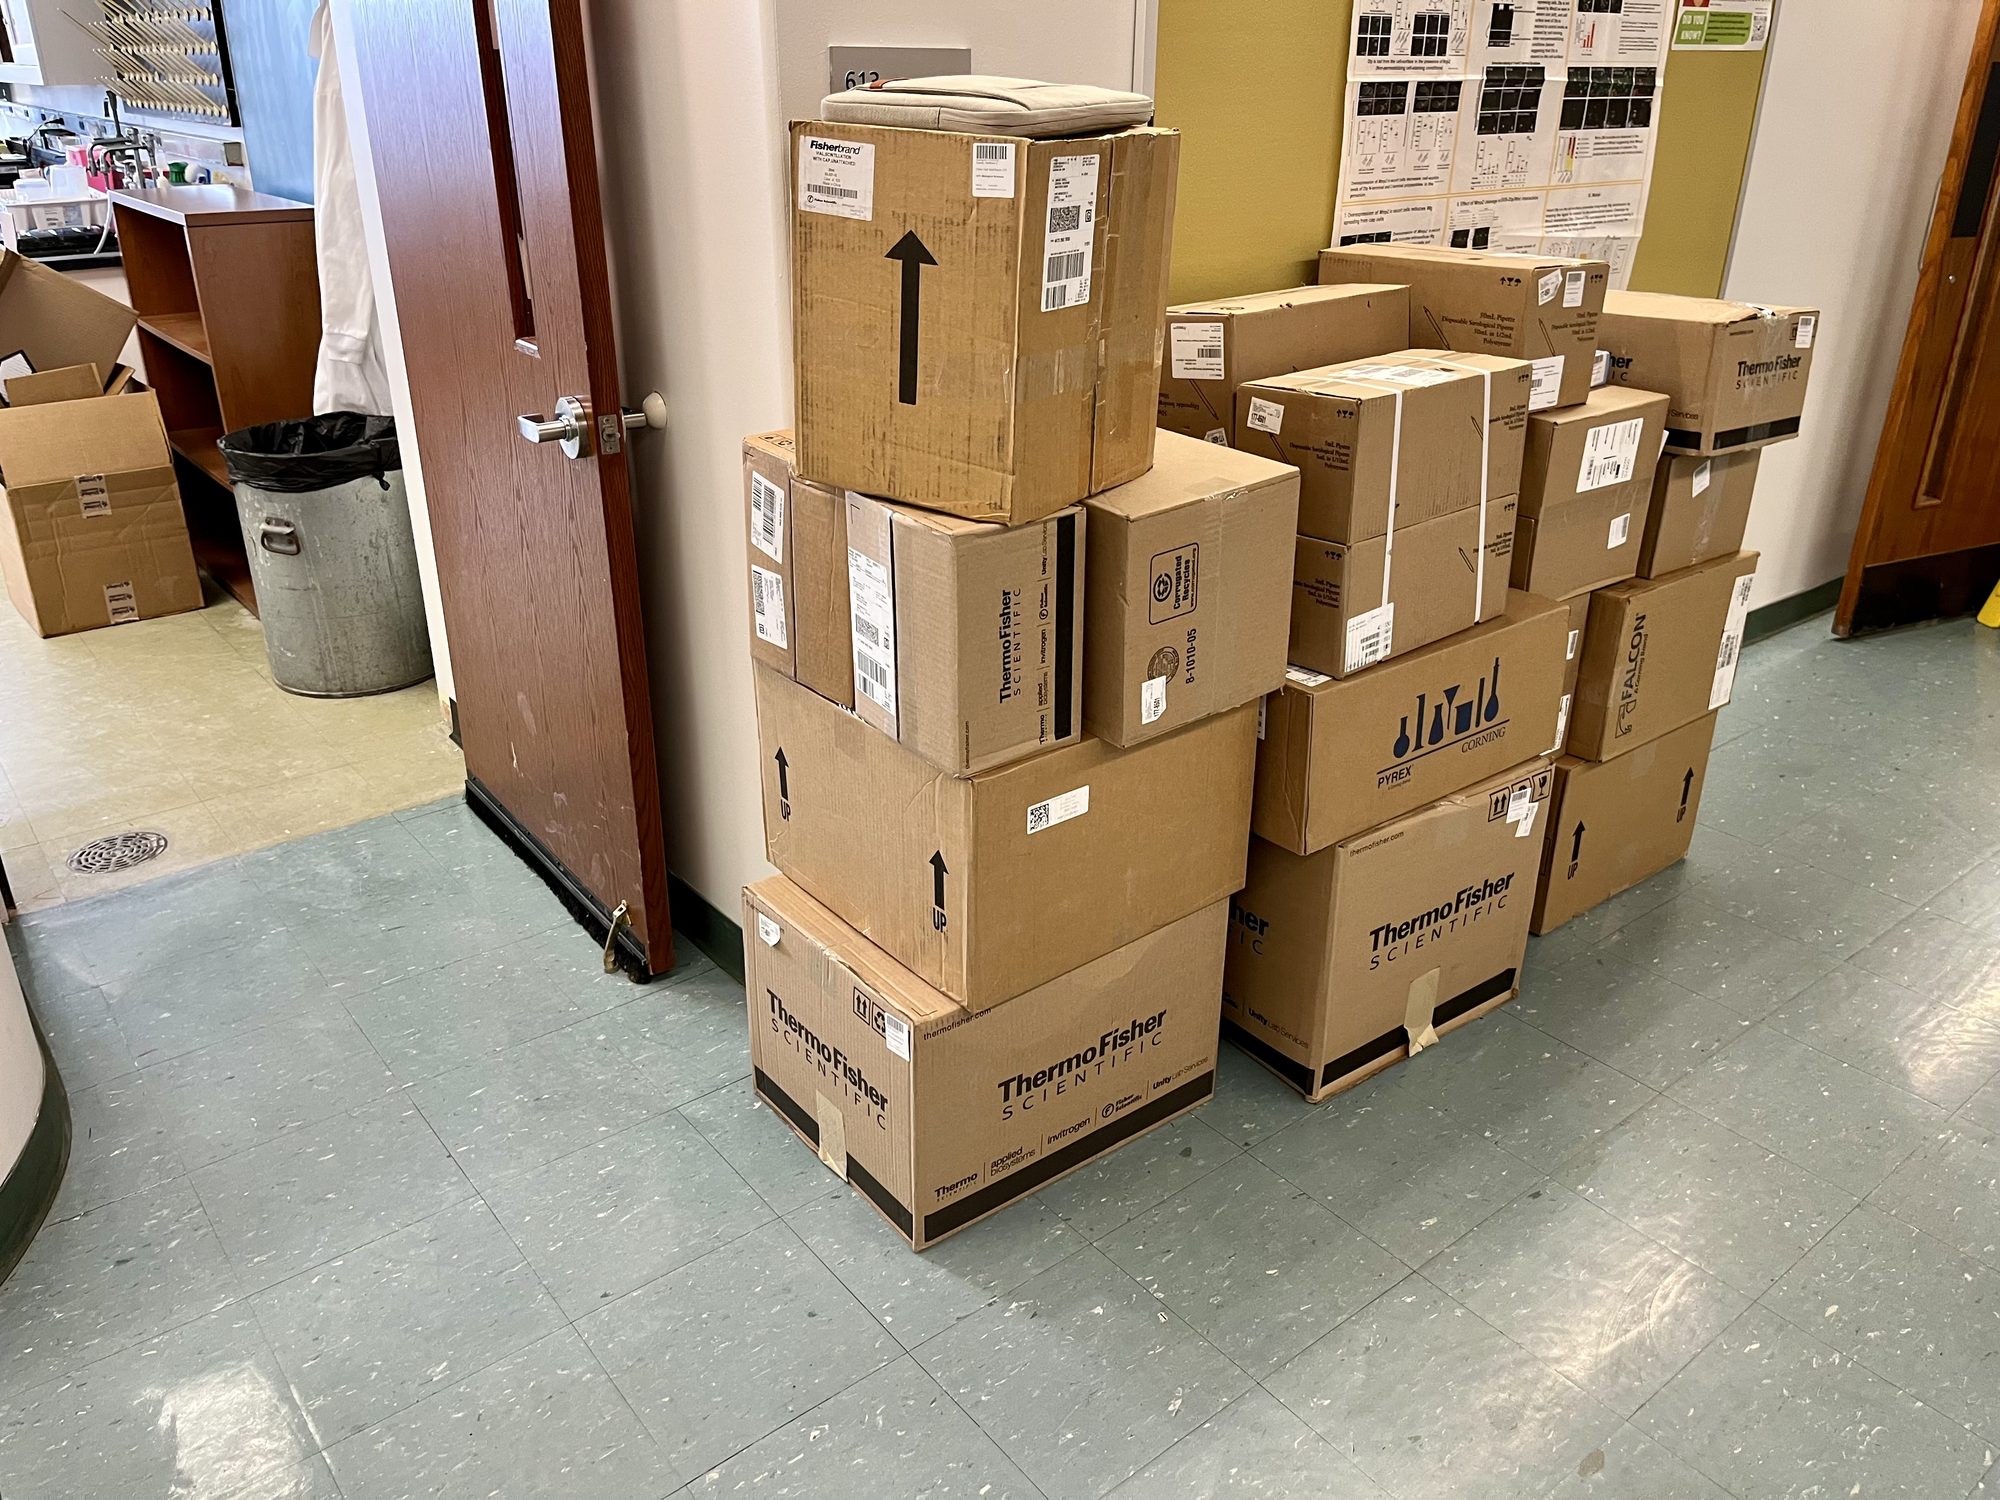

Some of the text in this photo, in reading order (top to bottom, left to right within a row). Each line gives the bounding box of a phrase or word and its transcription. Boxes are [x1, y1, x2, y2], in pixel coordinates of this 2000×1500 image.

[810, 140, 861, 155] Fisherbrand
[1174, 555, 1183, 610] Corrugated
[1182, 558, 1190, 602] Recycles
[1013, 588, 1021, 696] SCIENTIFIC
[1186, 628, 1197, 684] 8-1010-05
[1622, 614, 1646, 701] FALCON
[1635, 657, 1645, 687] Corning
[1461, 726, 1506, 753] CORNING
[1378, 766, 1412, 789] PYREX
[781, 799, 791, 822] UP
[1676, 806, 1686, 823] UP
[1350, 831, 1405, 857] thermofisher.com
[1568, 862, 1578, 880] UP
[933, 907, 946, 933] UP
[1370, 895, 1508, 970] SCIENTIFIC
[923, 1008, 991, 1040] thermofisher.com
[1249, 1008, 1268, 1026] Unity
[1280, 1027, 1308, 1049] Services
[772, 1018, 886, 1130] SCIENTIFIC
[1002, 1032, 1162, 1120] SCIENTIFIC
[1152, 1076, 1172, 1090] Unity
[1115, 1095, 1142, 1112] Scientific
[1116, 1094, 1134, 1106] Fisher
[1048, 1117, 1090, 1145] invitrogen
[990, 1149, 1036, 1176] biosystems
[991, 1146, 1023, 1168] applied
[934, 1173, 978, 1198] Thermo
